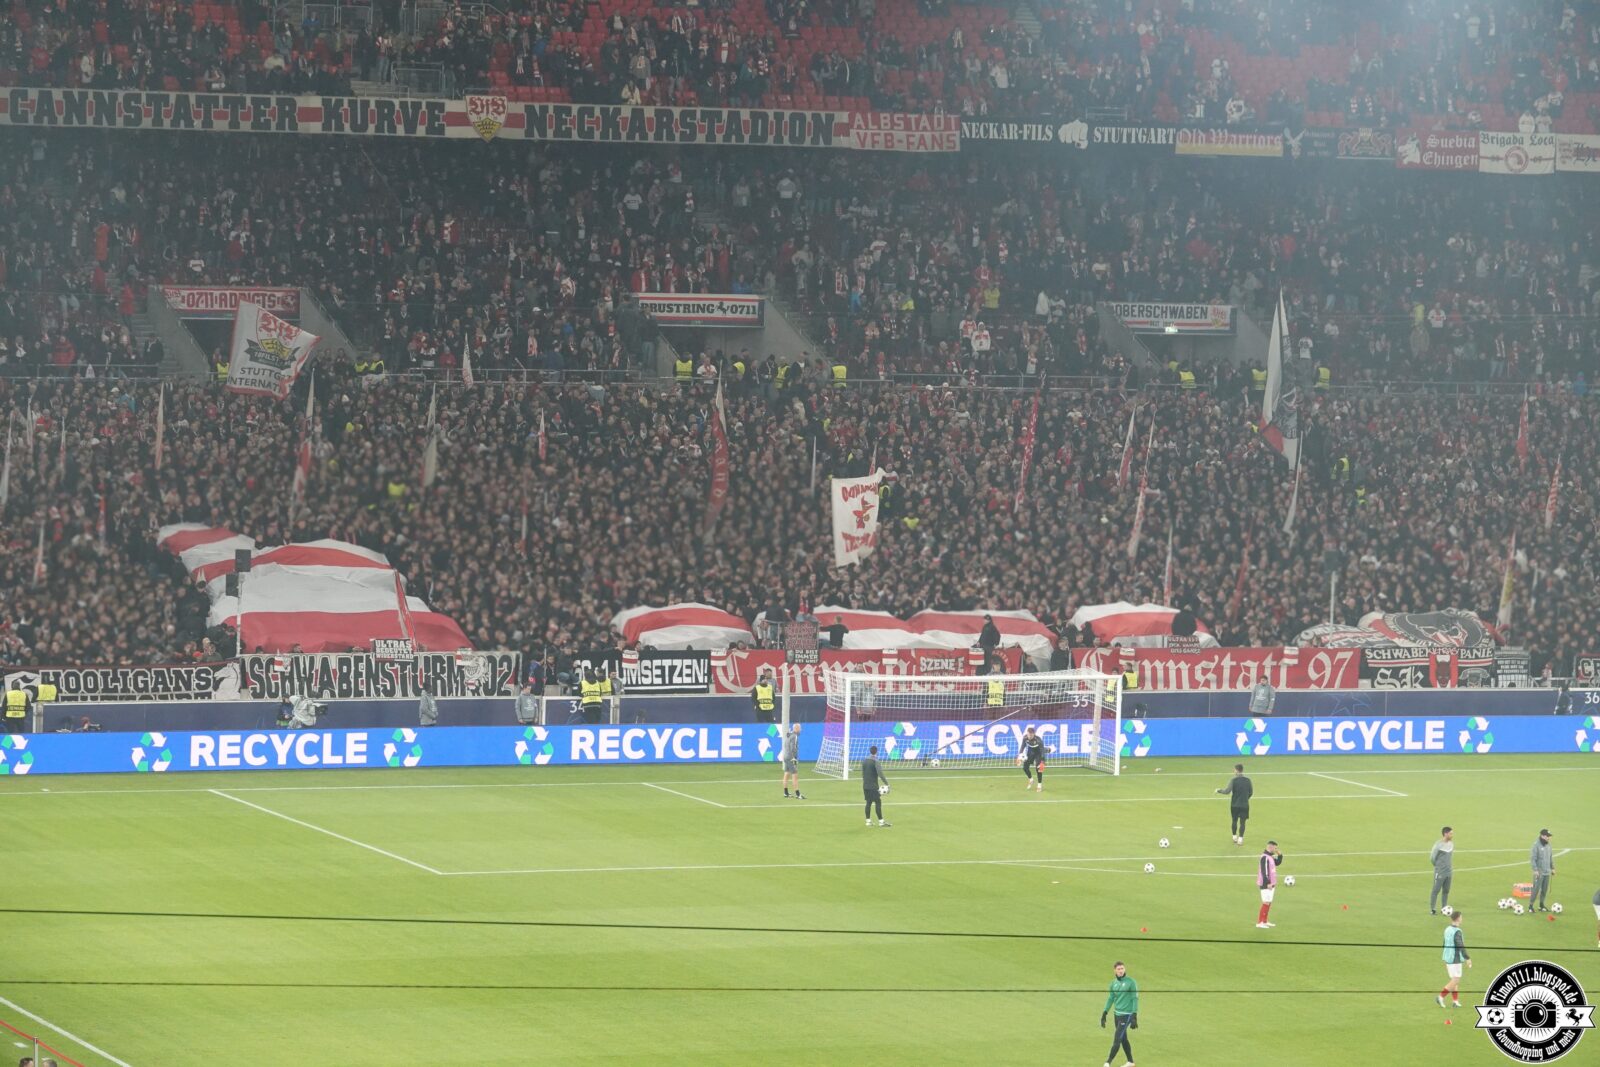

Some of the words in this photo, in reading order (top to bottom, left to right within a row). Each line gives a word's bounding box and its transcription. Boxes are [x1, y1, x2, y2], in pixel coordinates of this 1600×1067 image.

[9, 88, 297, 131] CANNSTATTER
[321, 97, 446, 136] KURVE
[853, 112, 961, 131] ALBSTADT
[524, 104, 835, 146] NECKARSTADION
[960, 122, 1053, 142] NECKAR-FILS
[1093, 126, 1177, 145] STUTTGART
[856, 131, 957, 151] VFB-FANS
[1210, 127, 1284, 148] Warriors
[1529, 134, 1555, 146] Loca
[186, 292, 215, 309] 0711
[730, 303, 757, 315] 0711
[1115, 304, 1209, 319] OBERSCHWABEN
[375, 639, 412, 648] ULTRAS
[919, 656, 956, 673] SZENE
[1308, 650, 1354, 689] 97
[39, 666, 214, 695] HOOLIGANS
[250, 655, 466, 699] SCHWABENSTURM
[486, 655, 513, 698] 02
[1584, 692, 1600, 704] 36
[571, 727, 742, 761] RECYCLE
[937, 723, 1100, 755] RECYCLE
[1287, 720, 1445, 751] RECYCLE
[190, 732, 367, 767] RECYCLE
